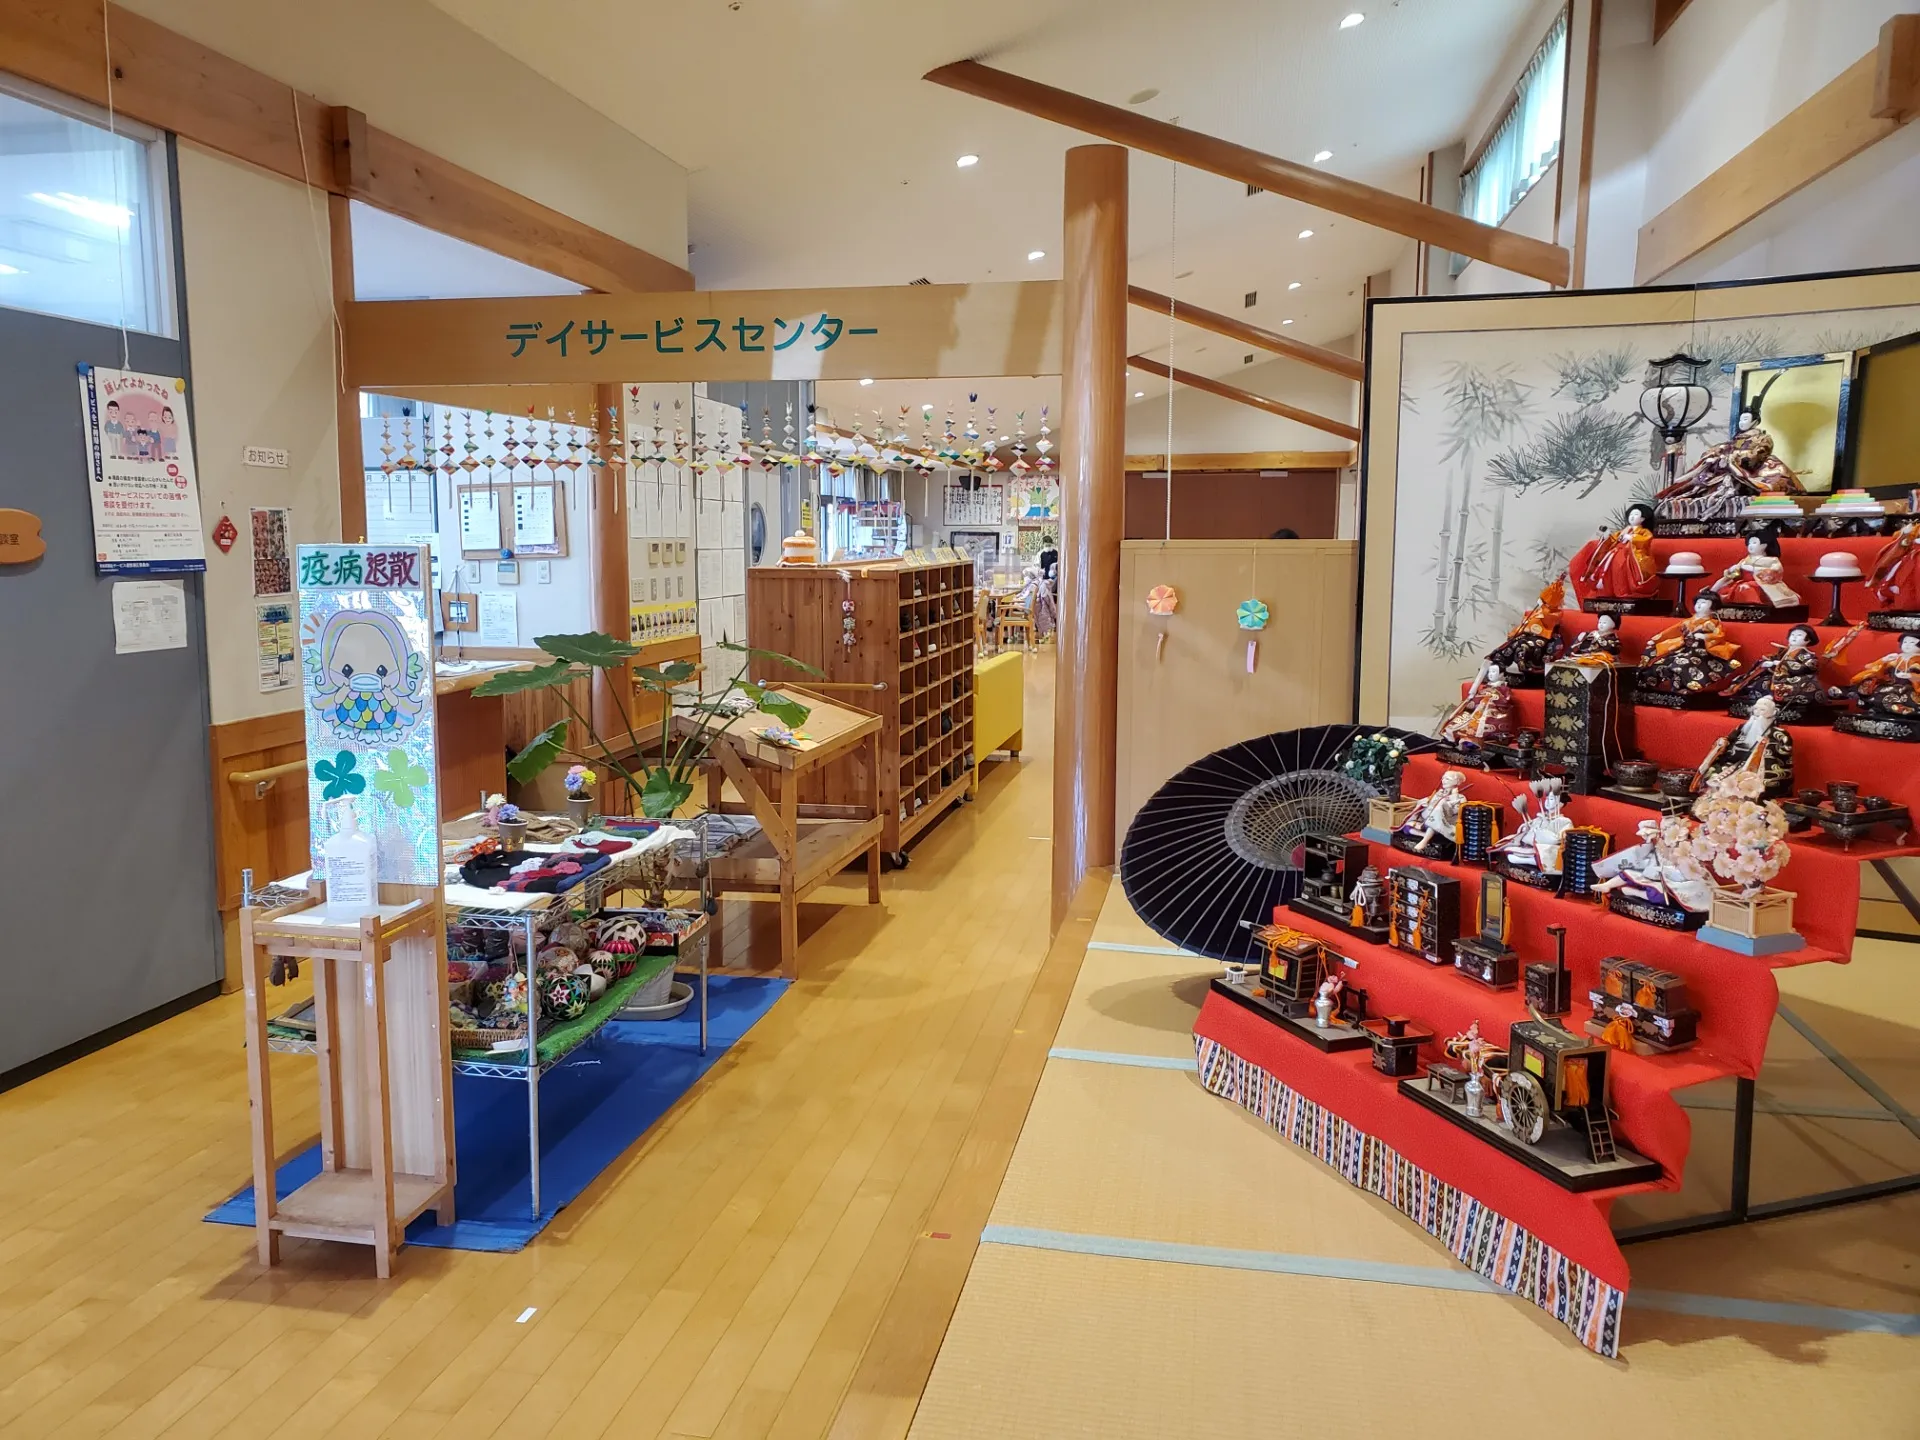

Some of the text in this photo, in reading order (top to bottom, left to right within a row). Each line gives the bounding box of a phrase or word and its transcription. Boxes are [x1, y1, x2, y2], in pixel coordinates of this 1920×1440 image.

[504, 313, 879, 357] デイサービスセンター
[301, 549, 419, 587] 疫病退散
